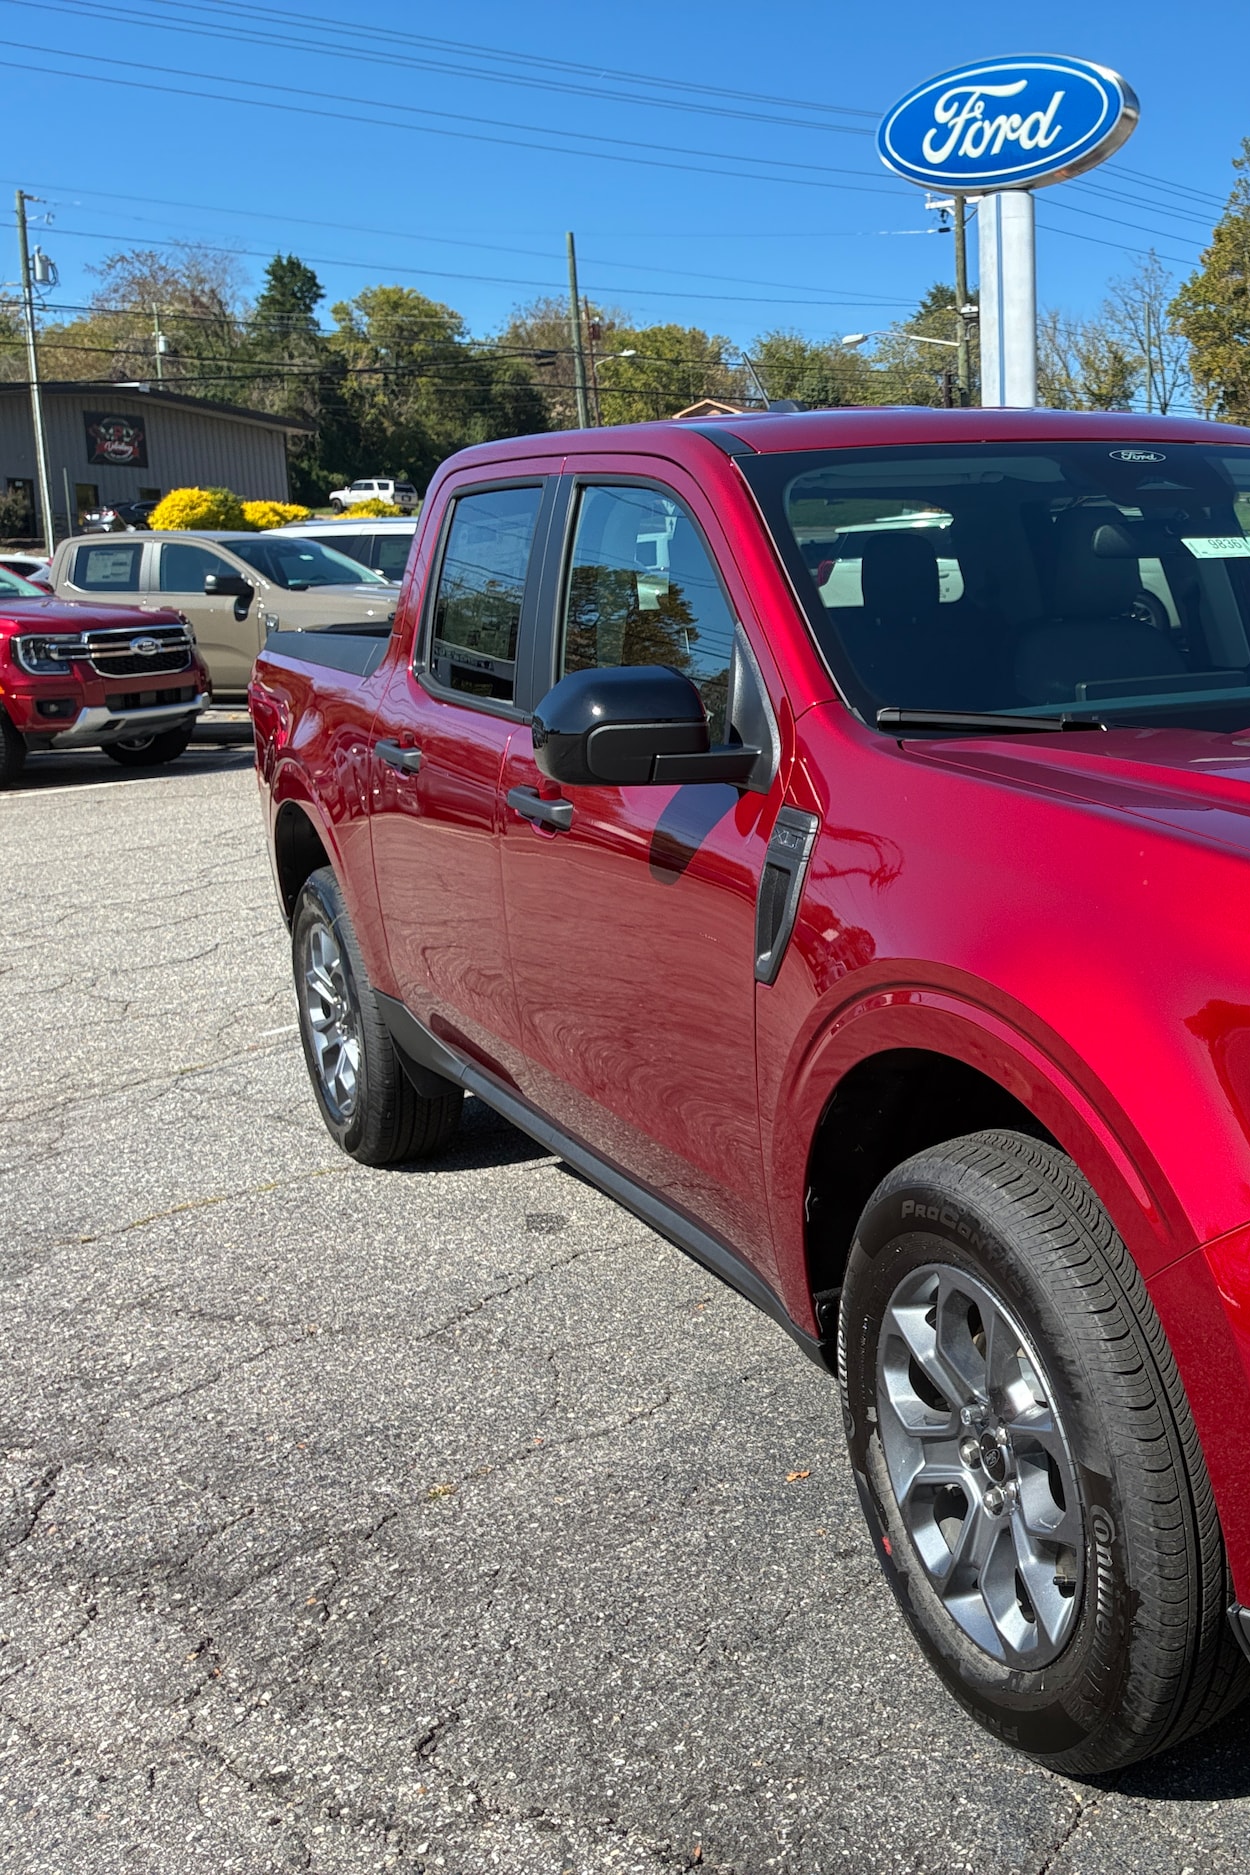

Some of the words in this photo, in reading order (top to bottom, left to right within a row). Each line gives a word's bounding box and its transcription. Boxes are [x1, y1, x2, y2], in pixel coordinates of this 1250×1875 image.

[922, 79, 1066, 164] Ford
[1120, 450, 1157, 461] Ford
[771, 827, 806, 849] XLT
